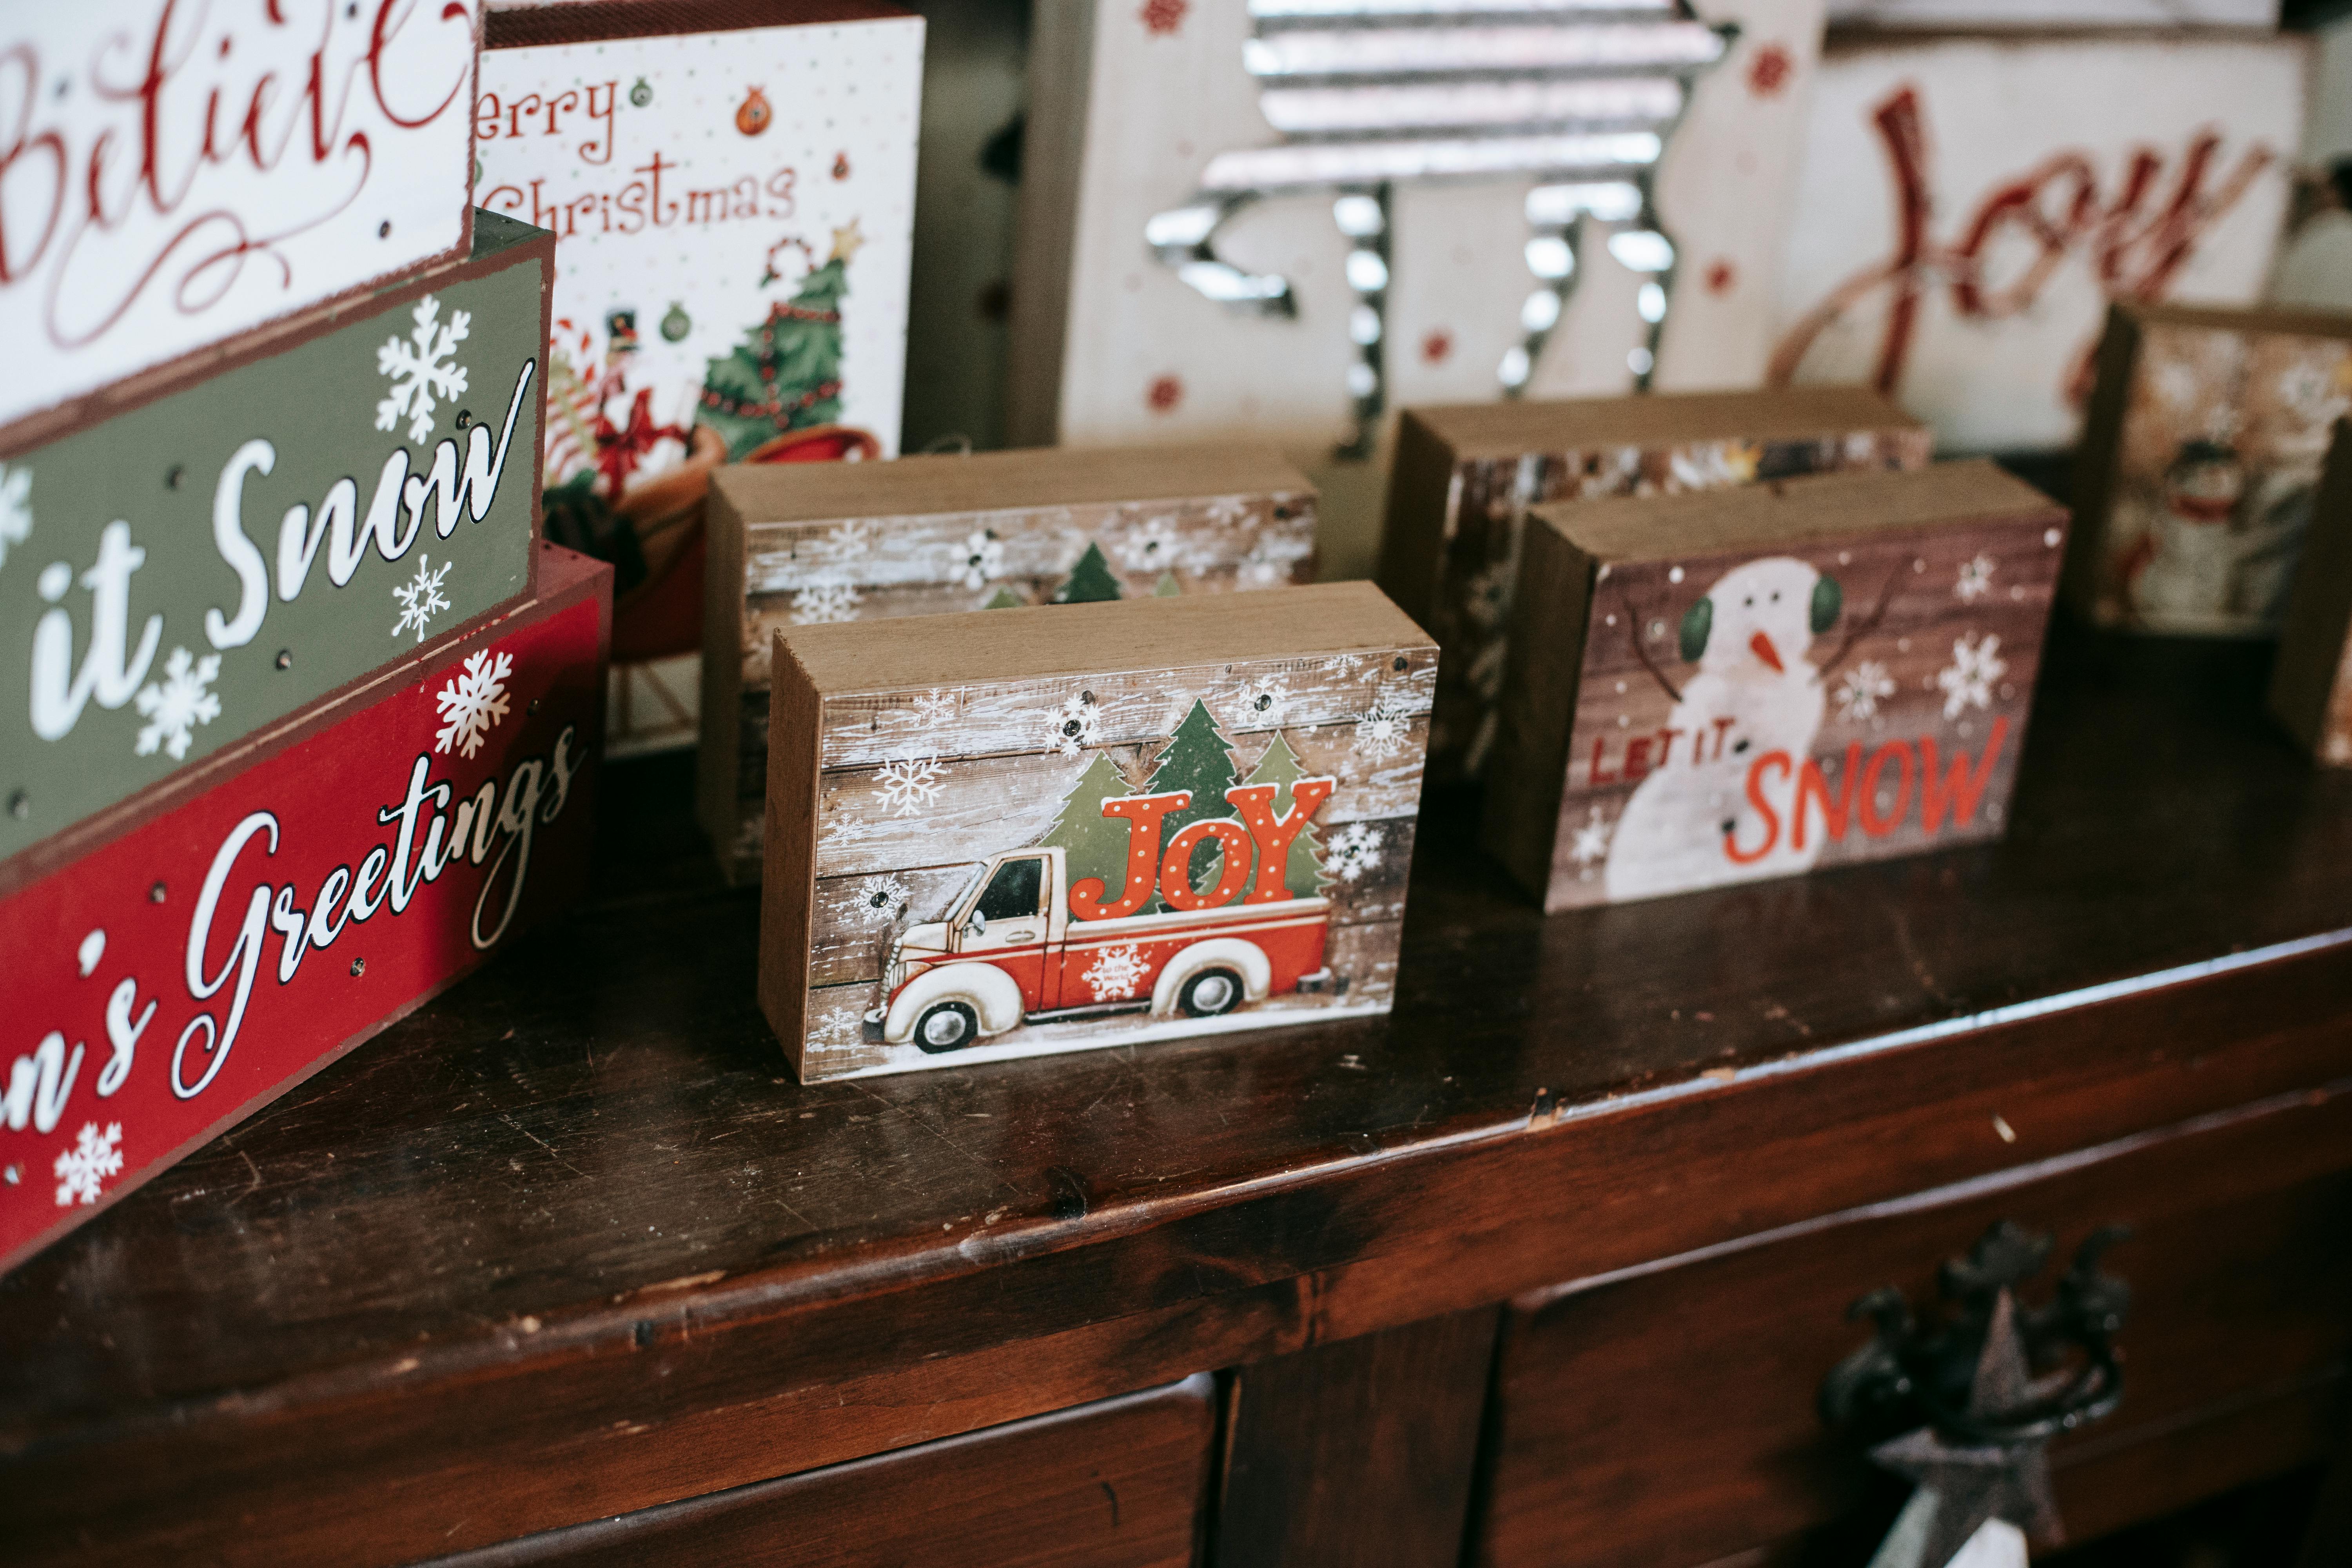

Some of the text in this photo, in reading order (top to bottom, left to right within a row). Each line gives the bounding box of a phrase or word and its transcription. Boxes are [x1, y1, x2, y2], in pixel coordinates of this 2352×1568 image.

[475, 80, 618, 165] erry
[29, 357, 536, 741] it Snow
[1589, 715, 1736, 784] LET IT
[1724, 715, 2009, 864] SNOW
[1069, 775, 1336, 921] JOY
[0, 724, 588, 1134] n's Greetings
